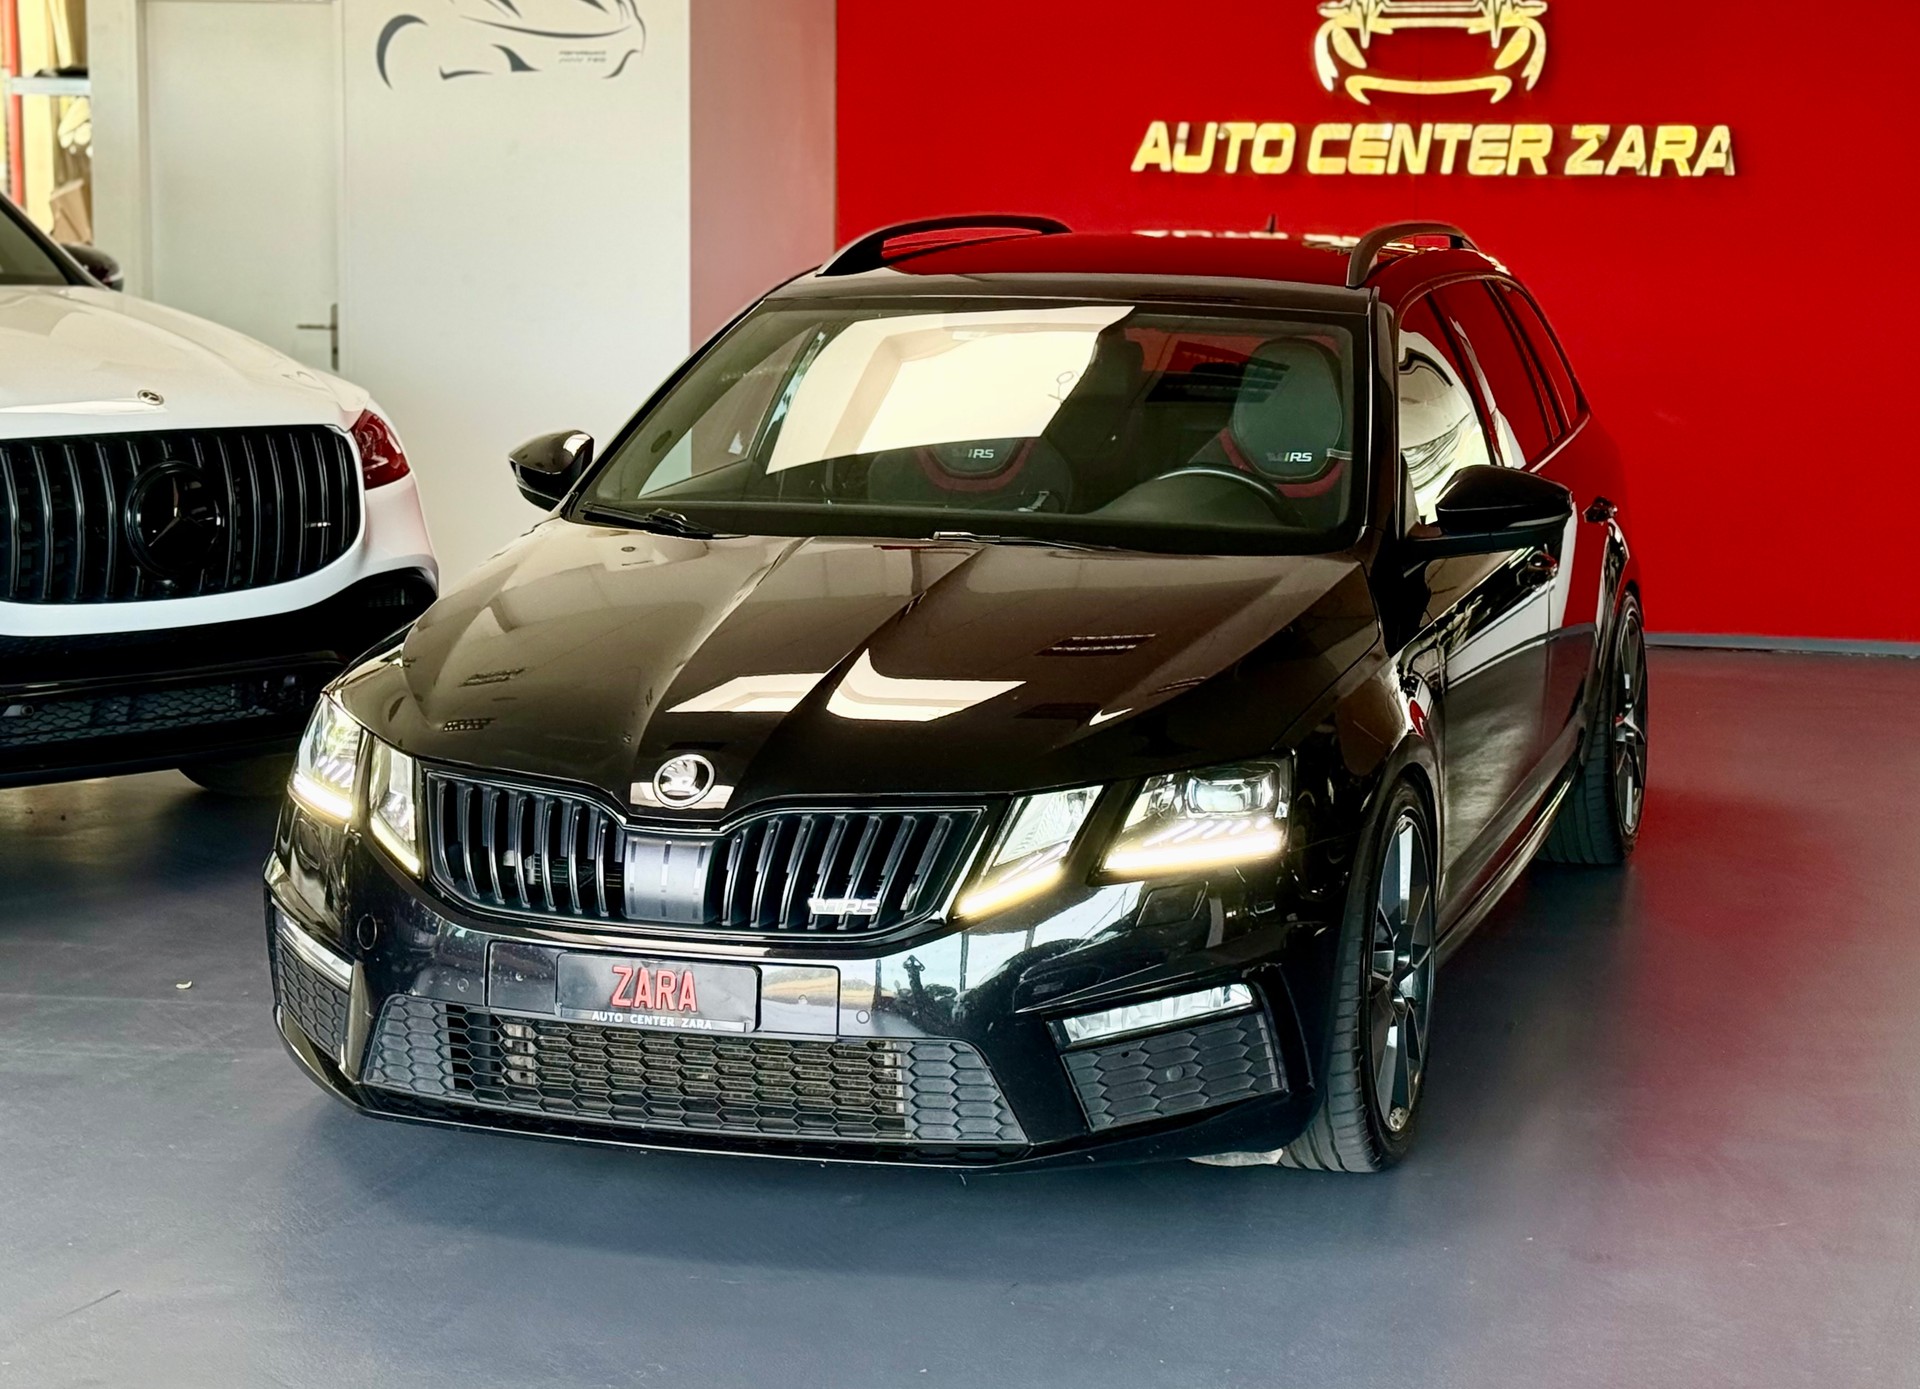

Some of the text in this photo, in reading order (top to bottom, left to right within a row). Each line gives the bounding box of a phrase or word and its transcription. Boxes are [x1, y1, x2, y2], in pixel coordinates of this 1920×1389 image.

[1130, 121, 1736, 177] AUTO CENTER ZARA
[610, 964, 698, 1013] ZARA
[591, 1010, 713, 1031] AUTO CENTER ZARA
